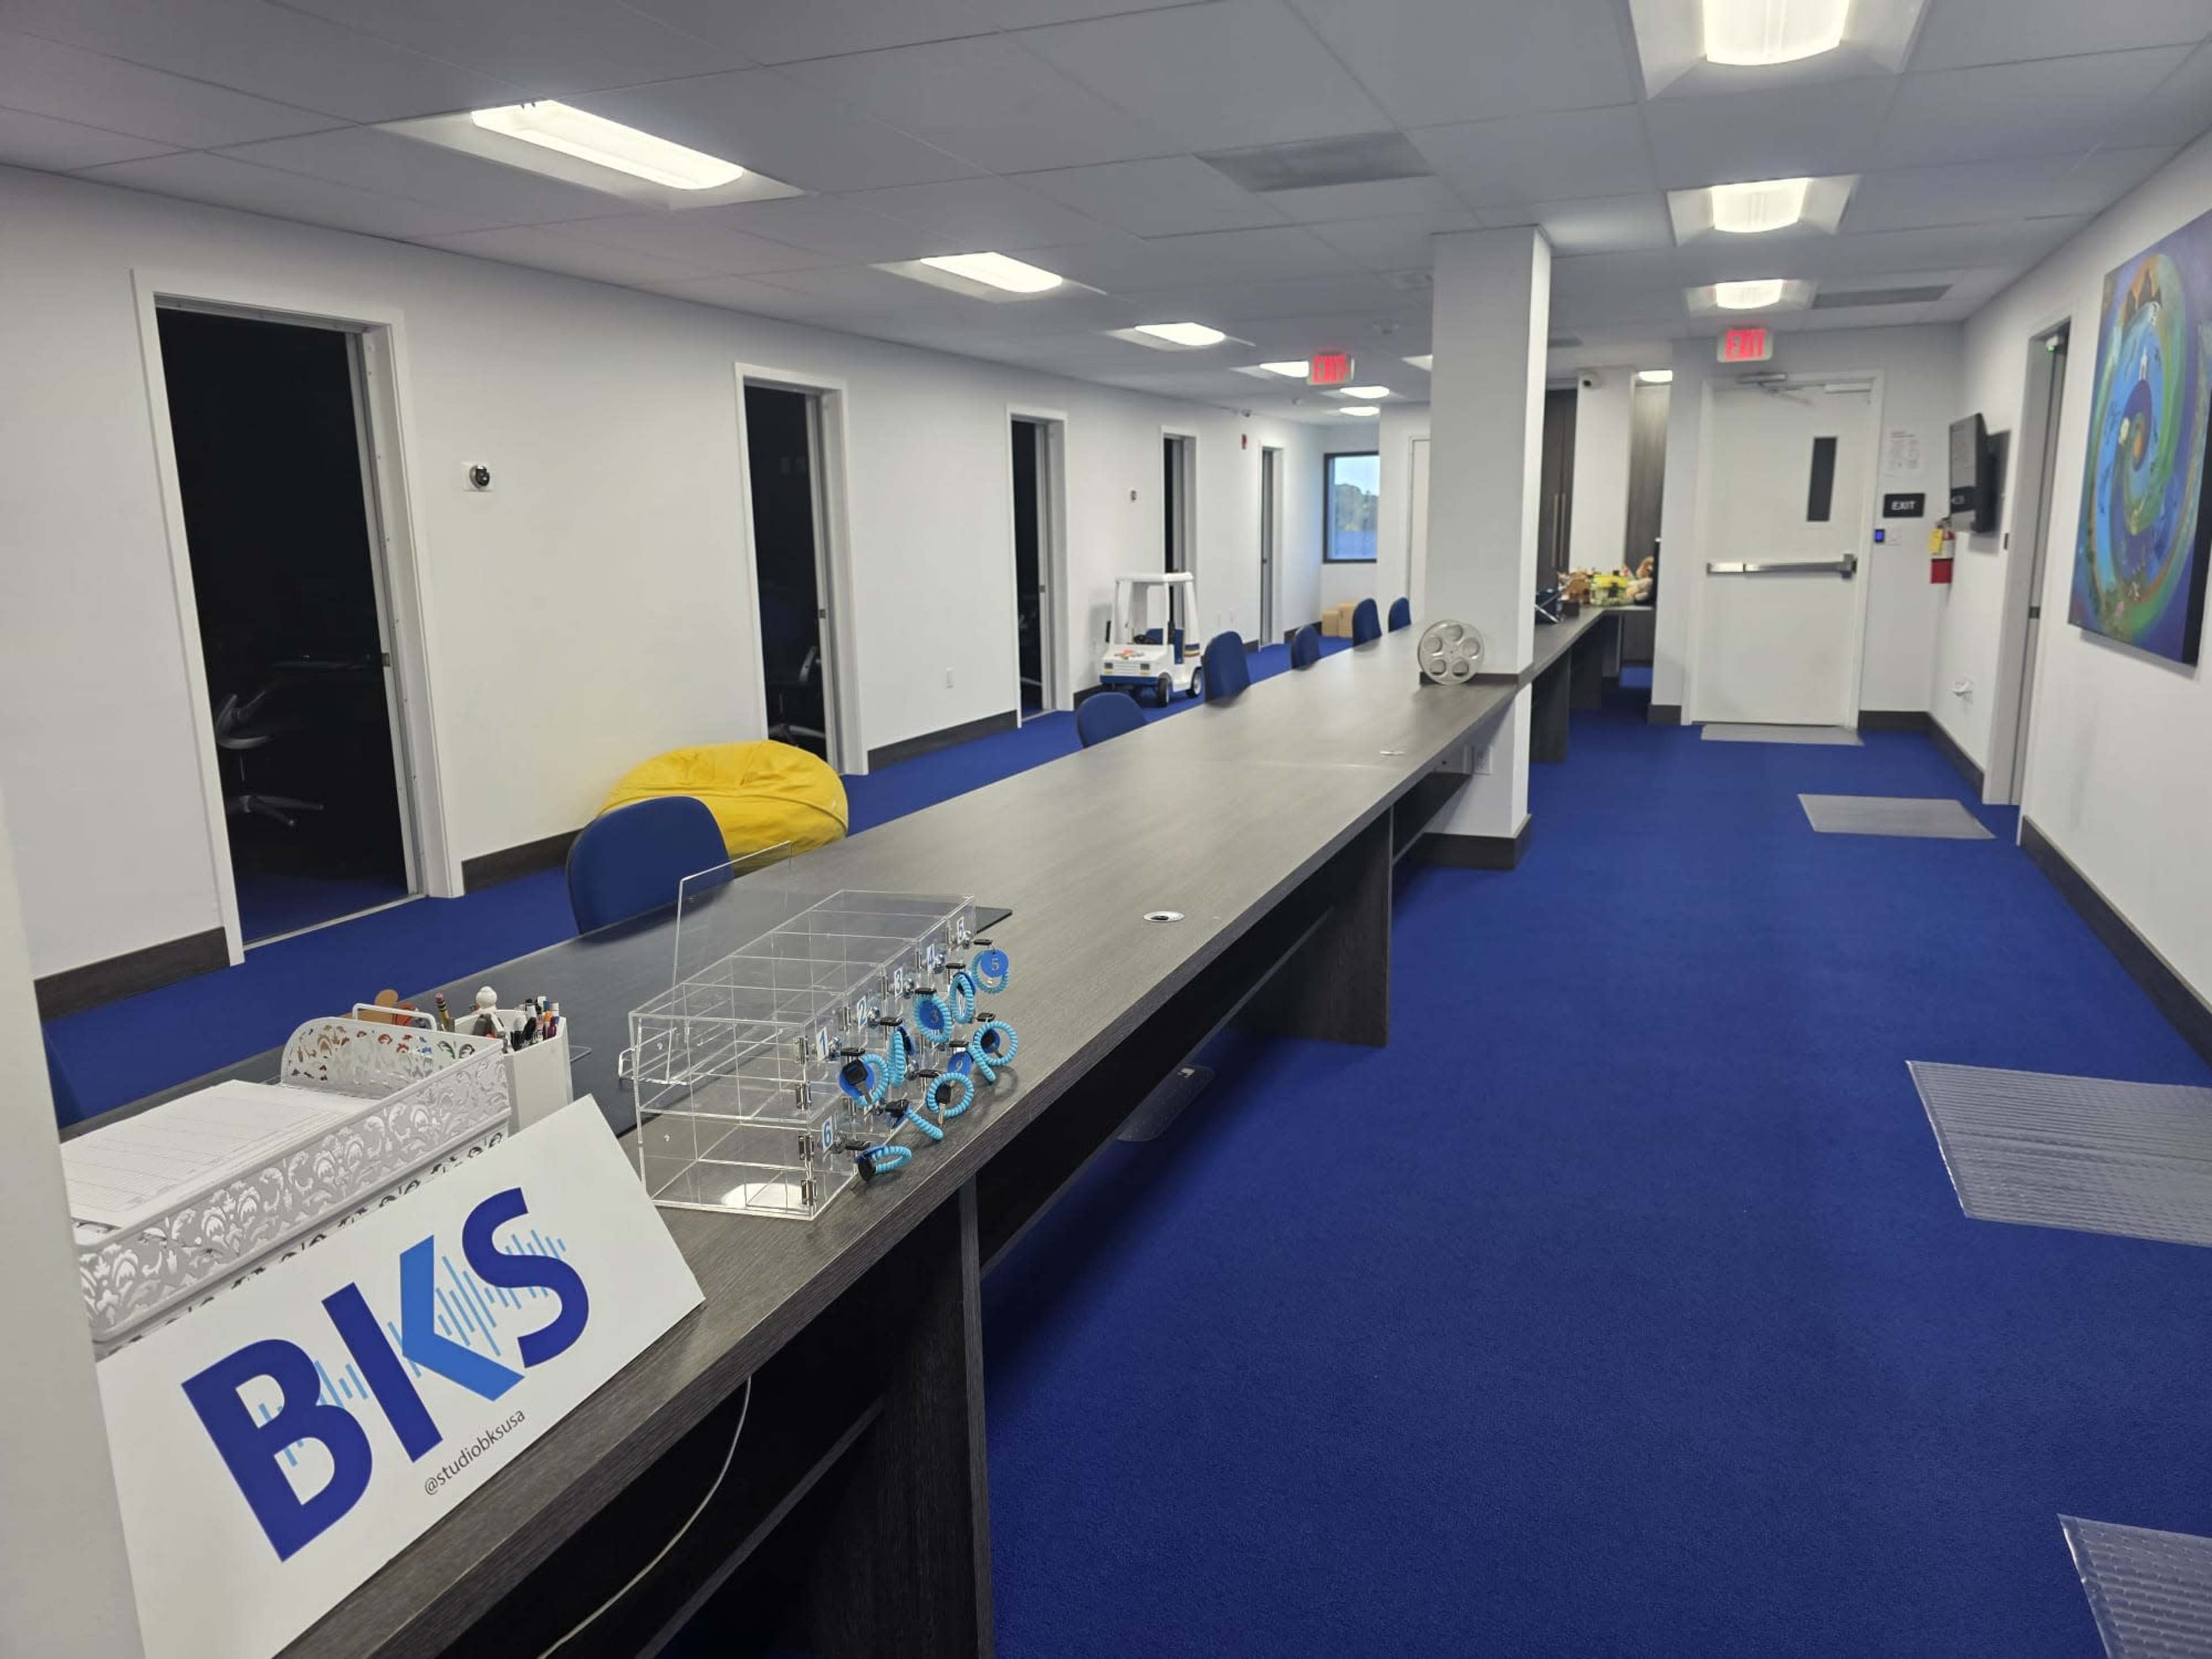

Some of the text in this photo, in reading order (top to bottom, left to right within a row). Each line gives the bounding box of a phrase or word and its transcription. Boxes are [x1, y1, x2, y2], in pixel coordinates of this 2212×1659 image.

[1725, 329, 1766, 358] EXIT
[1313, 354, 1346, 384] EXIT
[1891, 500, 1916, 510] EXIT
[991, 957, 999, 971] 5
[895, 969, 902, 995] 3
[858, 1000, 866, 1026] 2
[930, 1010, 939, 1024] 3
[819, 1031, 826, 1054] 1
[824, 1120, 832, 1148] 6
[181, 1187, 589, 1563] BKS
[425, 1410, 525, 1495] @studiobksusa
